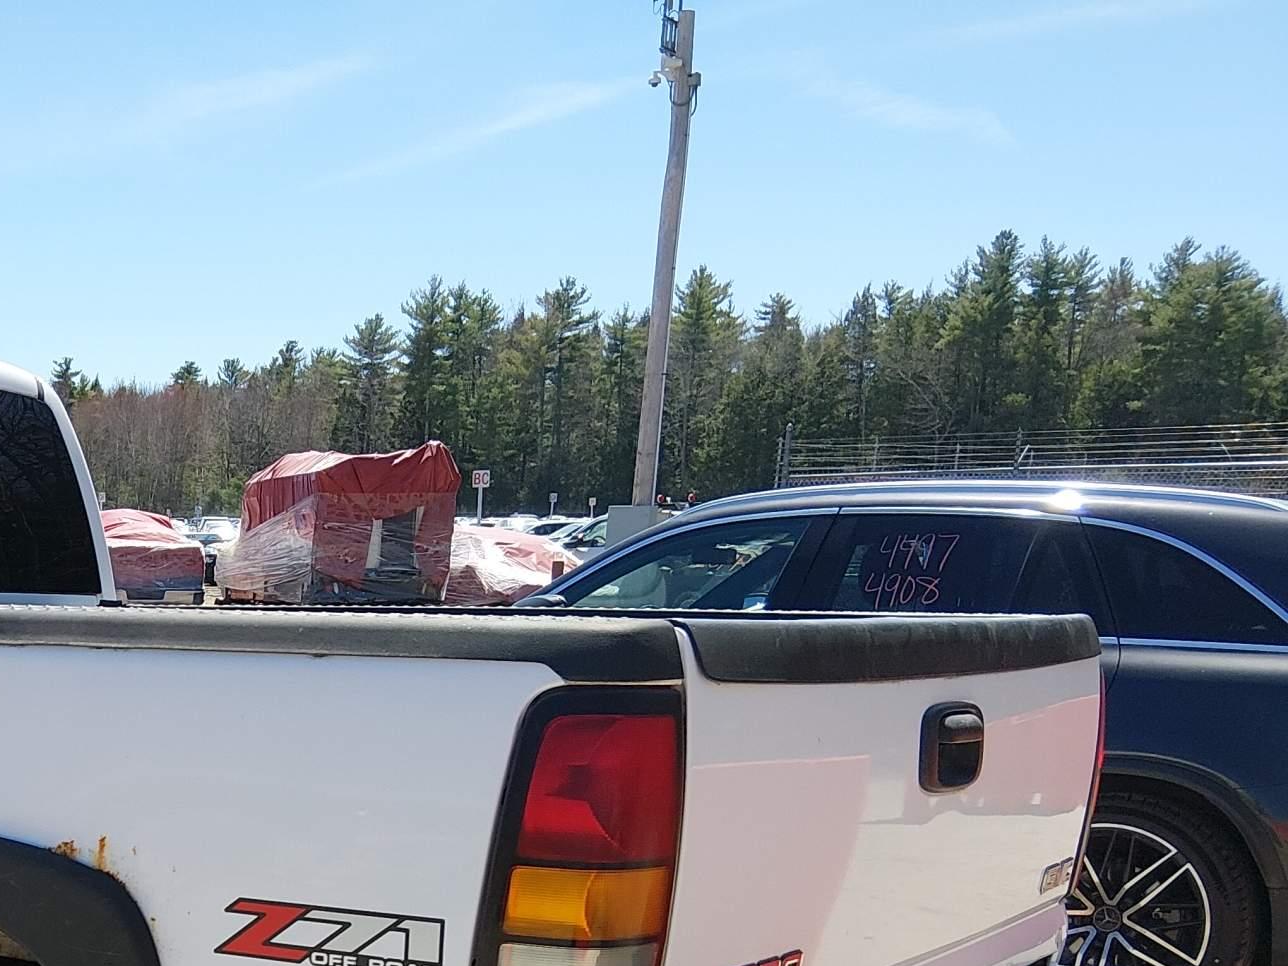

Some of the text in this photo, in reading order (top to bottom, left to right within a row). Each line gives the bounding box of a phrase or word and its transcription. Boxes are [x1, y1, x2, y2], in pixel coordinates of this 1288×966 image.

[473, 472, 489, 486] BC
[880, 533, 960, 572] 4497
[864, 572, 941, 610] 4908
[213, 897, 445, 964] Z71
